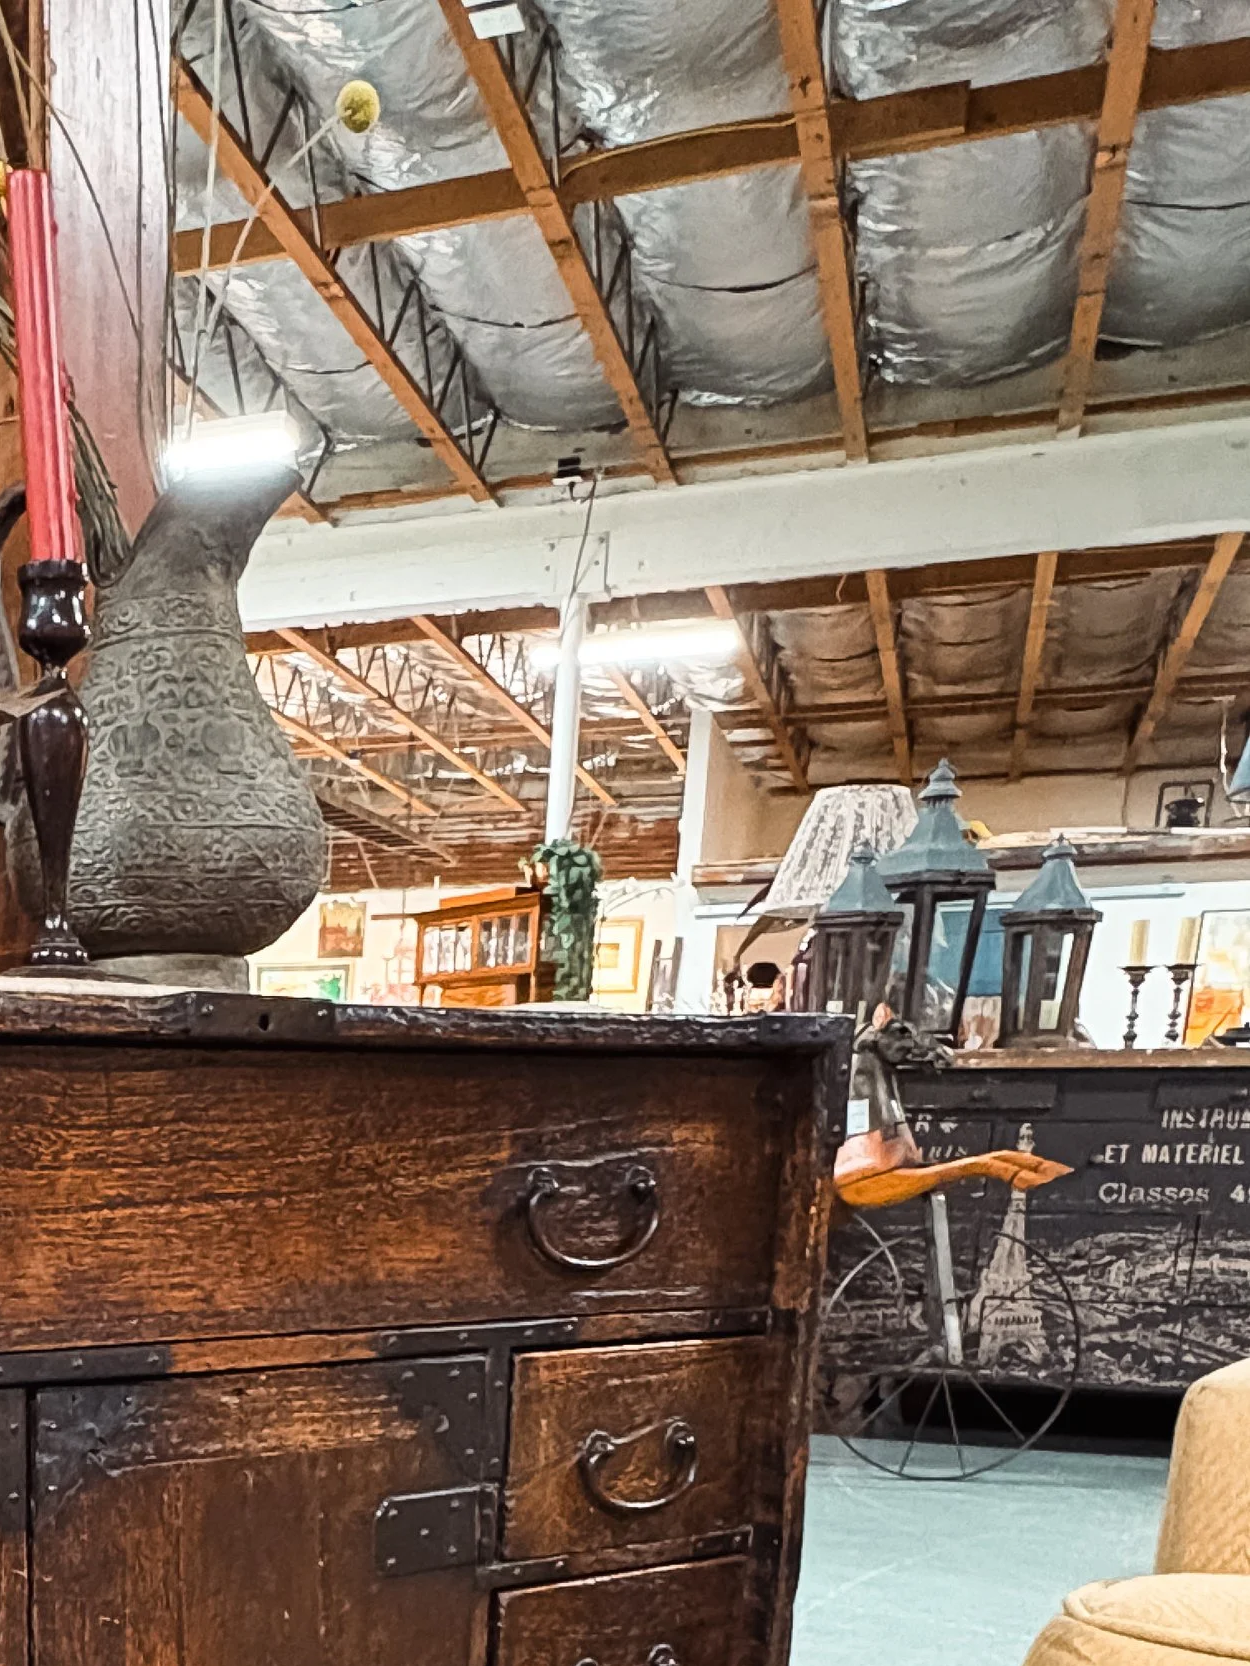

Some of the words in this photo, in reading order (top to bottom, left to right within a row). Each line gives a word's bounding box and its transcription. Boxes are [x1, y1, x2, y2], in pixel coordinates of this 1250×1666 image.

[1104, 1143, 1131, 1165] ET
[1141, 1142, 1246, 1165] MATERIEL
[1099, 1182, 1211, 1206] Classes
